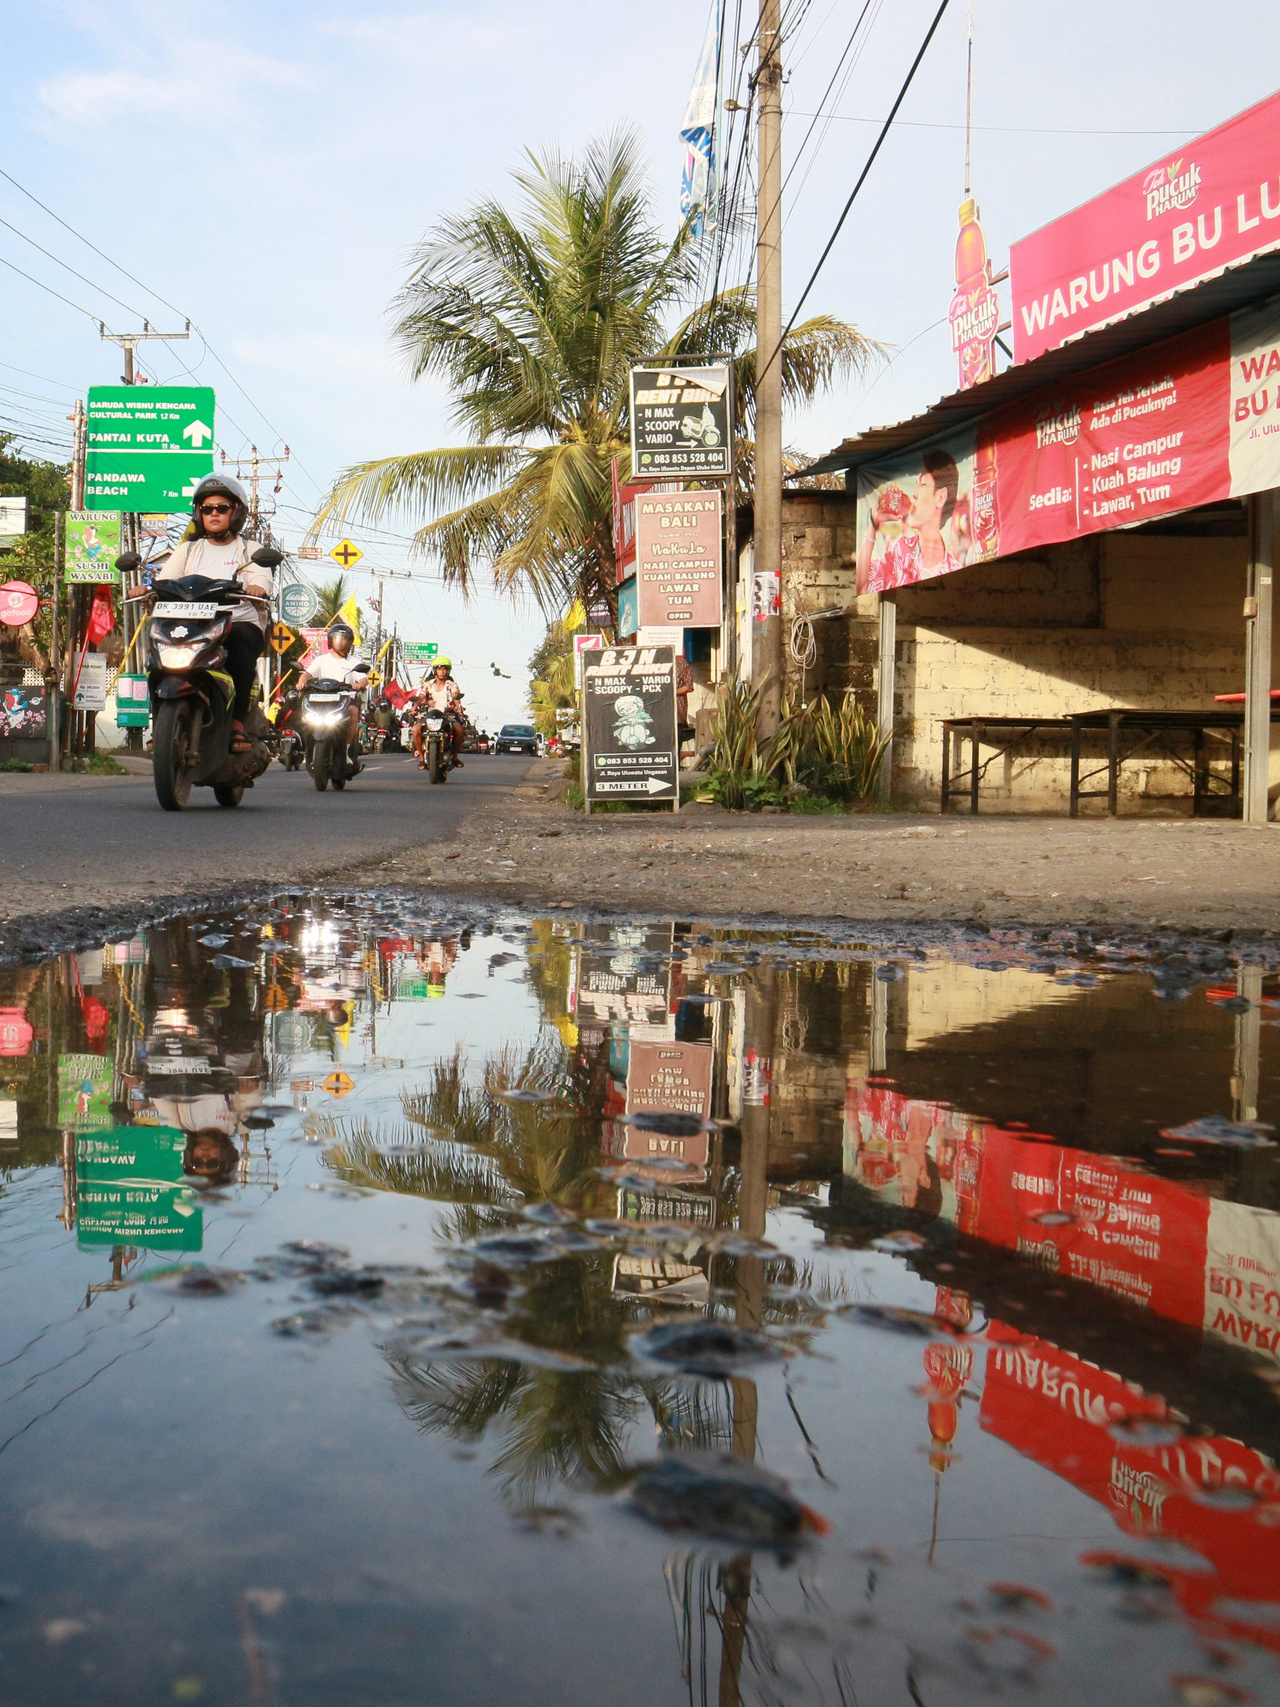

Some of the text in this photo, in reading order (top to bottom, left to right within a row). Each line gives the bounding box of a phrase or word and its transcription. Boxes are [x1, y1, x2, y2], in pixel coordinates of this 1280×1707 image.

[1155, 188, 1198, 215] HARUM
[1020, 239, 1161, 336] WARUNG
[1172, 205, 1222, 264] BU
[960, 318, 995, 341] HARUM
[635, 389, 681, 405] RENT
[1093, 375, 1174, 414] Rasa Teh Terbaik
[1090, 390, 1177, 430] Ada di Pucuknya!
[1234, 390, 1269, 422] BU
[654, 407, 674, 417] MAX
[645, 420, 680, 431] SCOOPY
[89, 433, 169, 442] PANTAI KUTA
[645, 434, 673, 444] VARIO
[1042, 426, 1080, 446] HARUM
[1250, 428, 1260, 439] Jl.
[1091, 431, 1184, 472] Nasi Campur
[654, 453, 723, 464] 083 853 528 404
[88, 474, 145, 482] PANDAWA
[1092, 455, 1182, 495] Kuah Balung
[87, 487, 128, 495] BEACH
[1092, 484, 1171, 518] Lawar, Tum
[642, 501, 715, 514] MASAKAN
[70, 513, 117, 521] WARUNG
[660, 515, 697, 528] BALI
[75, 562, 109, 570] SUSHI
[643, 559, 715, 571] NASI CAMPUR
[643, 571, 717, 582] KUAH BALUNG
[659, 583, 700, 593] LAWAR
[667, 595, 693, 605] TUM
[1, 609, 32, 618] gofood
[585, 663, 673, 676] RENT BIKE
[605, 677, 626, 686] MAX
[642, 676, 671, 684] VARIO
[595, 685, 662, 694] SCOOPY PCX
[654, 756, 669, 764] 404
